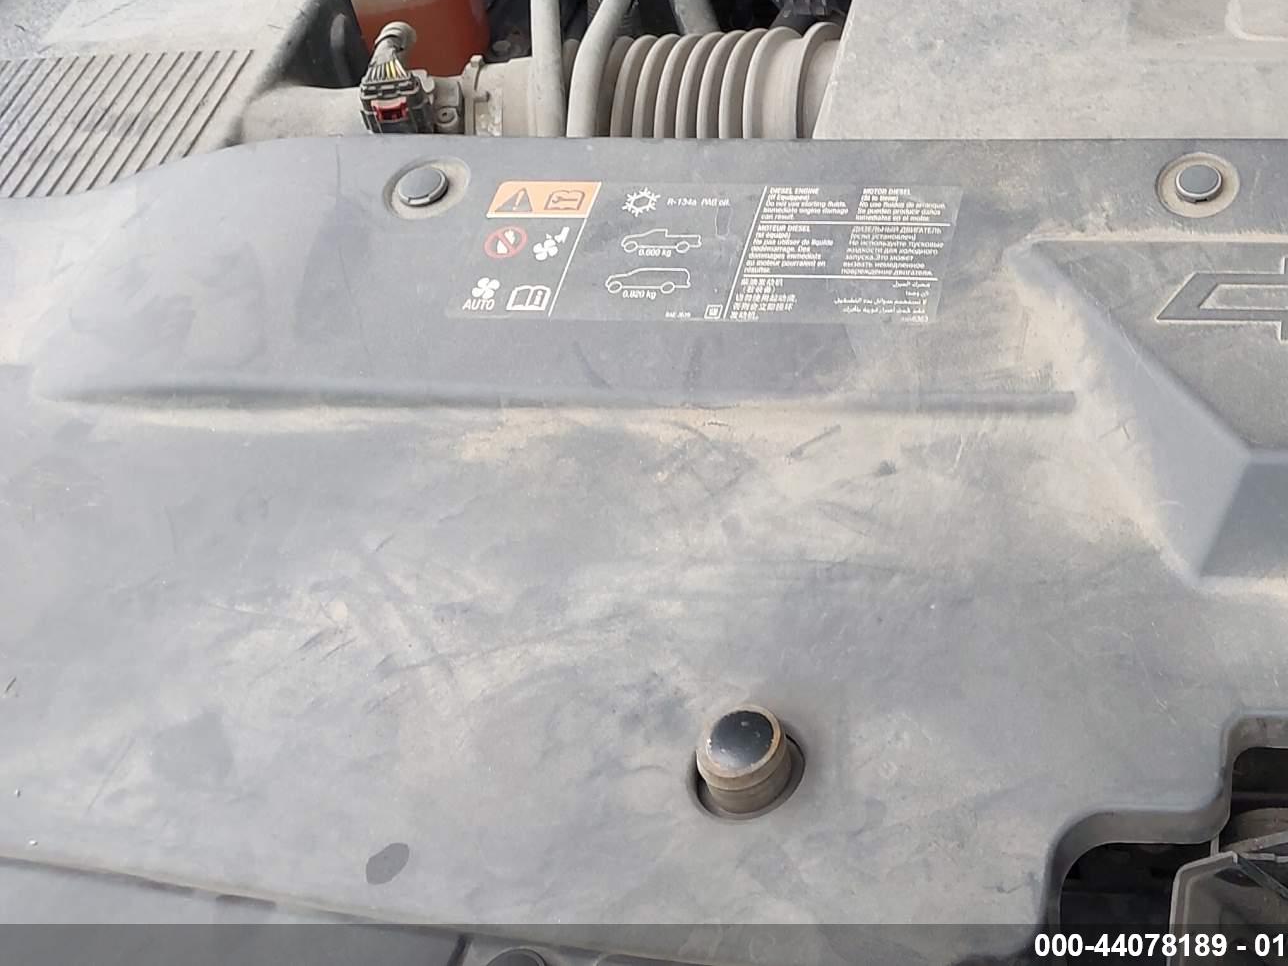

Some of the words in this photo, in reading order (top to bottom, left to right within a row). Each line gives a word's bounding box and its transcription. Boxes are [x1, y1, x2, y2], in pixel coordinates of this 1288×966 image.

[661, 249, 671, 257] kg
[646, 291, 656, 300] kg
[462, 298, 495, 310] AUTO
